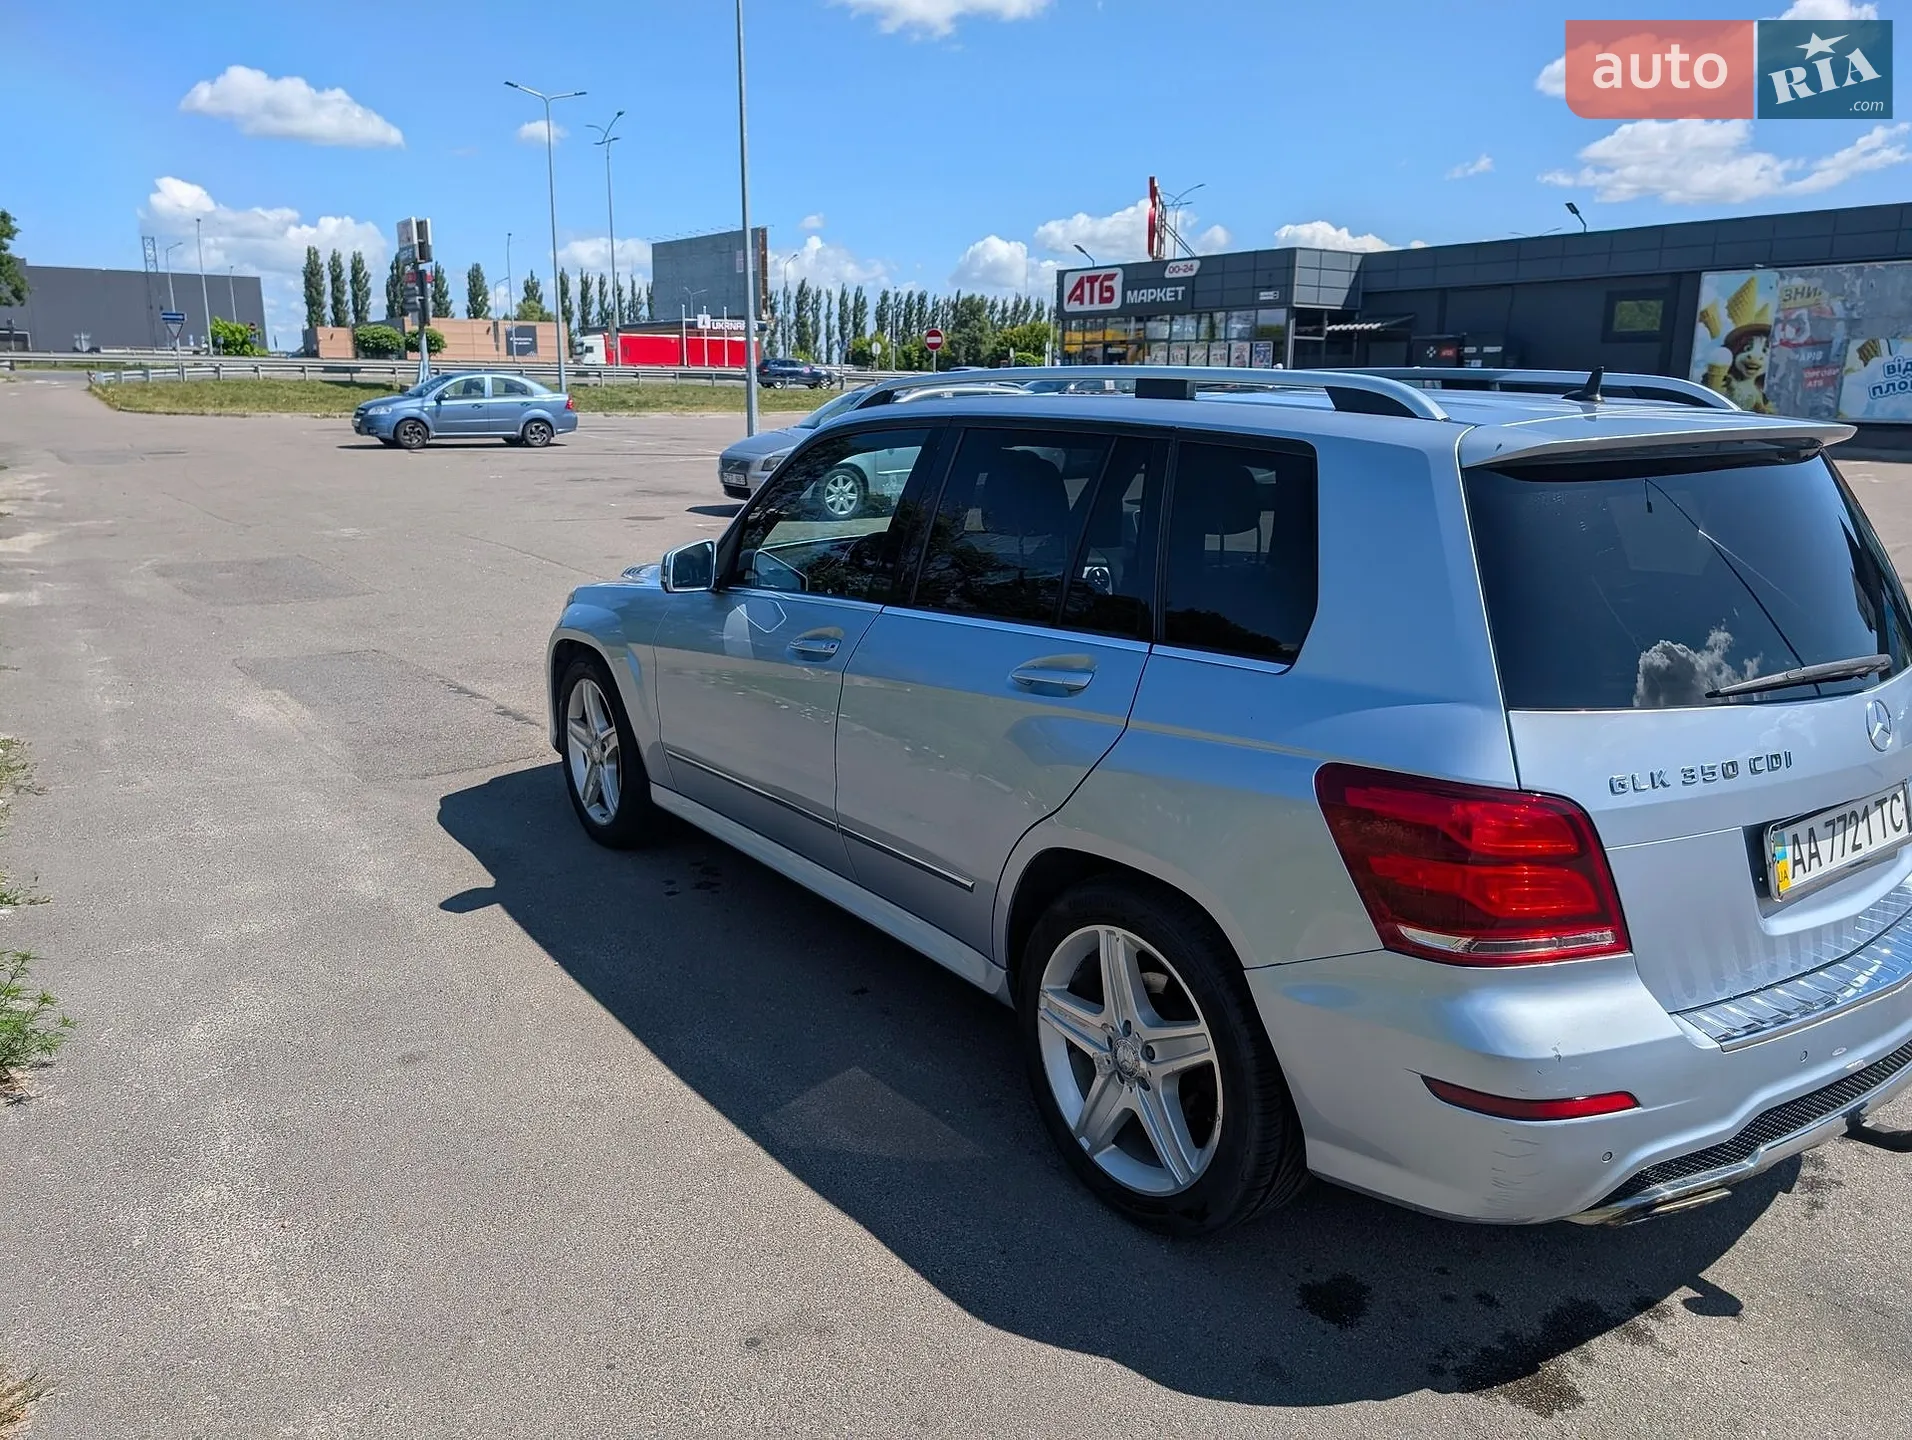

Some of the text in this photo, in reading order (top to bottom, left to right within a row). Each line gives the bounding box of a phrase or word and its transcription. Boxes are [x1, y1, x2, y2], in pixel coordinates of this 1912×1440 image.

[1067, 273, 1118, 305] АТБ
[1126, 286, 1186, 303] МАРКЕТ
[1783, 286, 1822, 302] ЗНИ
[1609, 750, 1793, 796] GLK 350 CDI
[1791, 792, 1904, 879] AA 7721 TC
